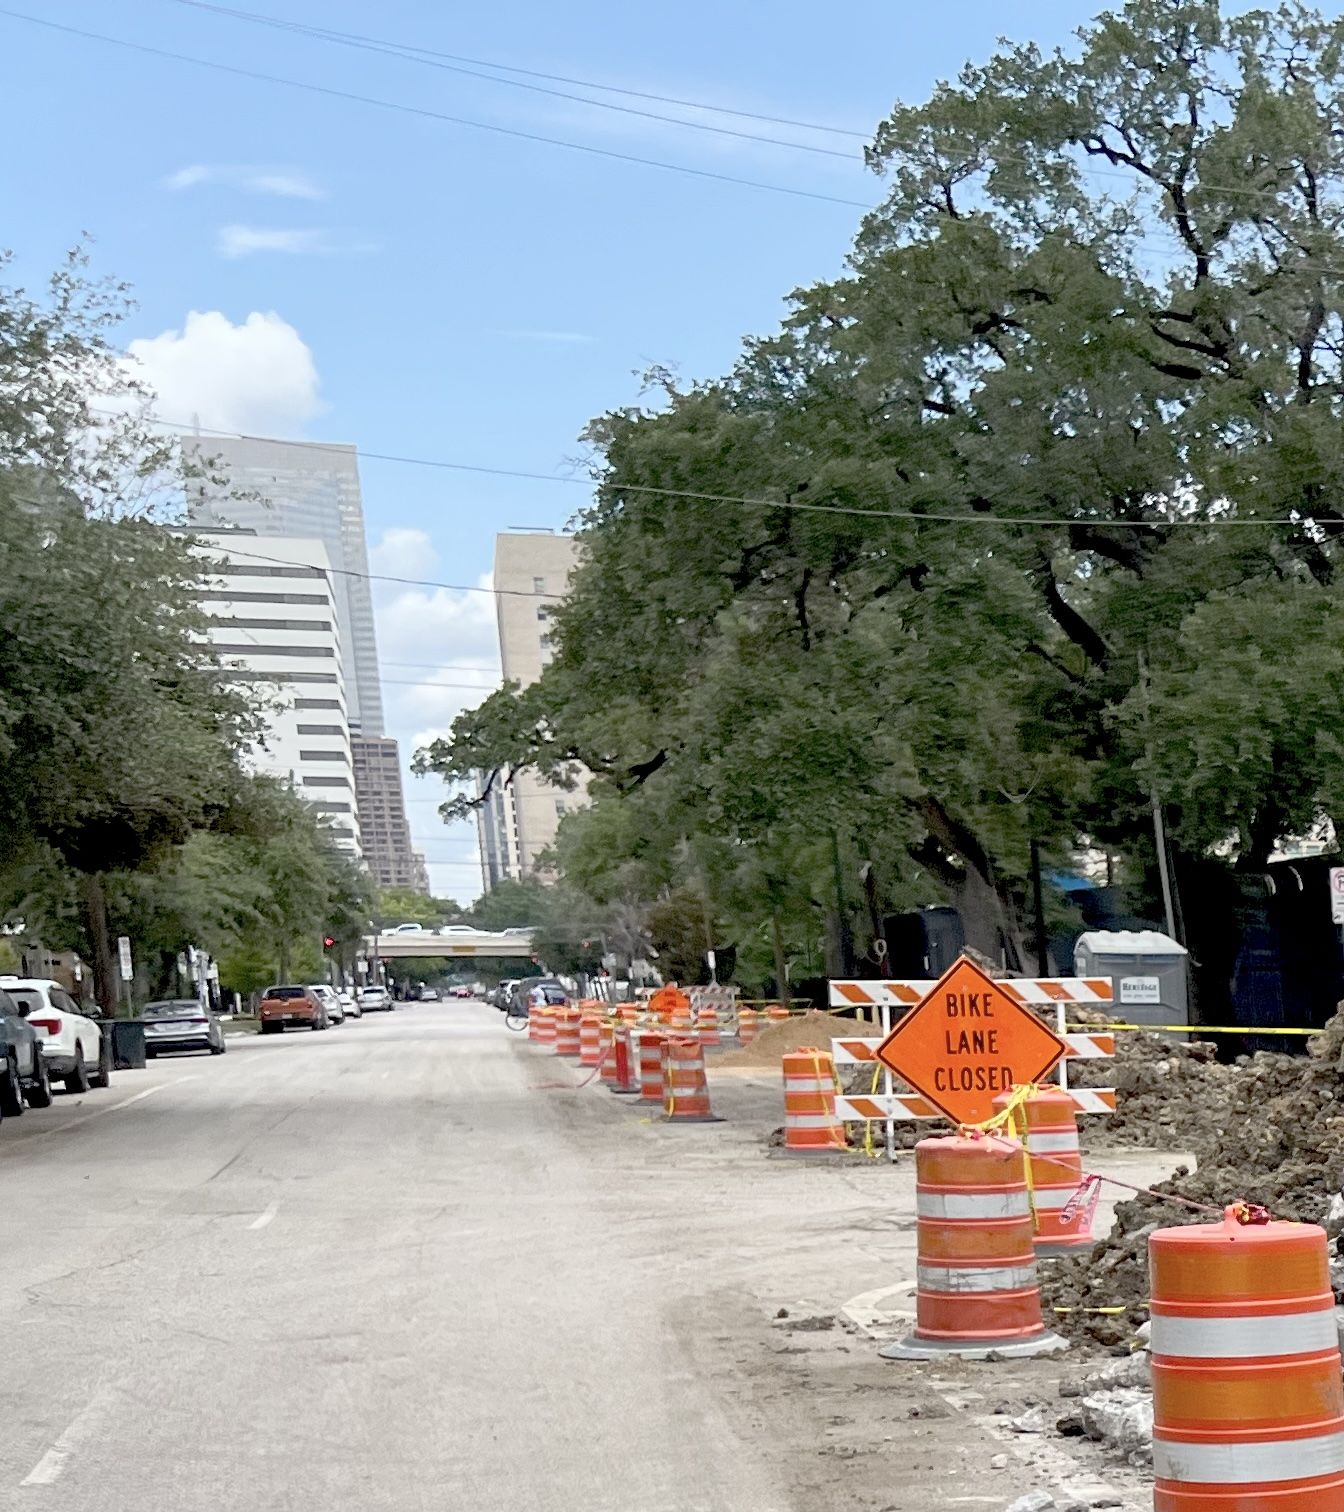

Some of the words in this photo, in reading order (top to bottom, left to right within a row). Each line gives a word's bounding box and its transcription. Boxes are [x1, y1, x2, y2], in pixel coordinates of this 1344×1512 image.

[946, 993, 993, 1018] BIKE
[946, 1030, 999, 1055] LANE
[934, 1066, 1013, 1091] CLOSED
